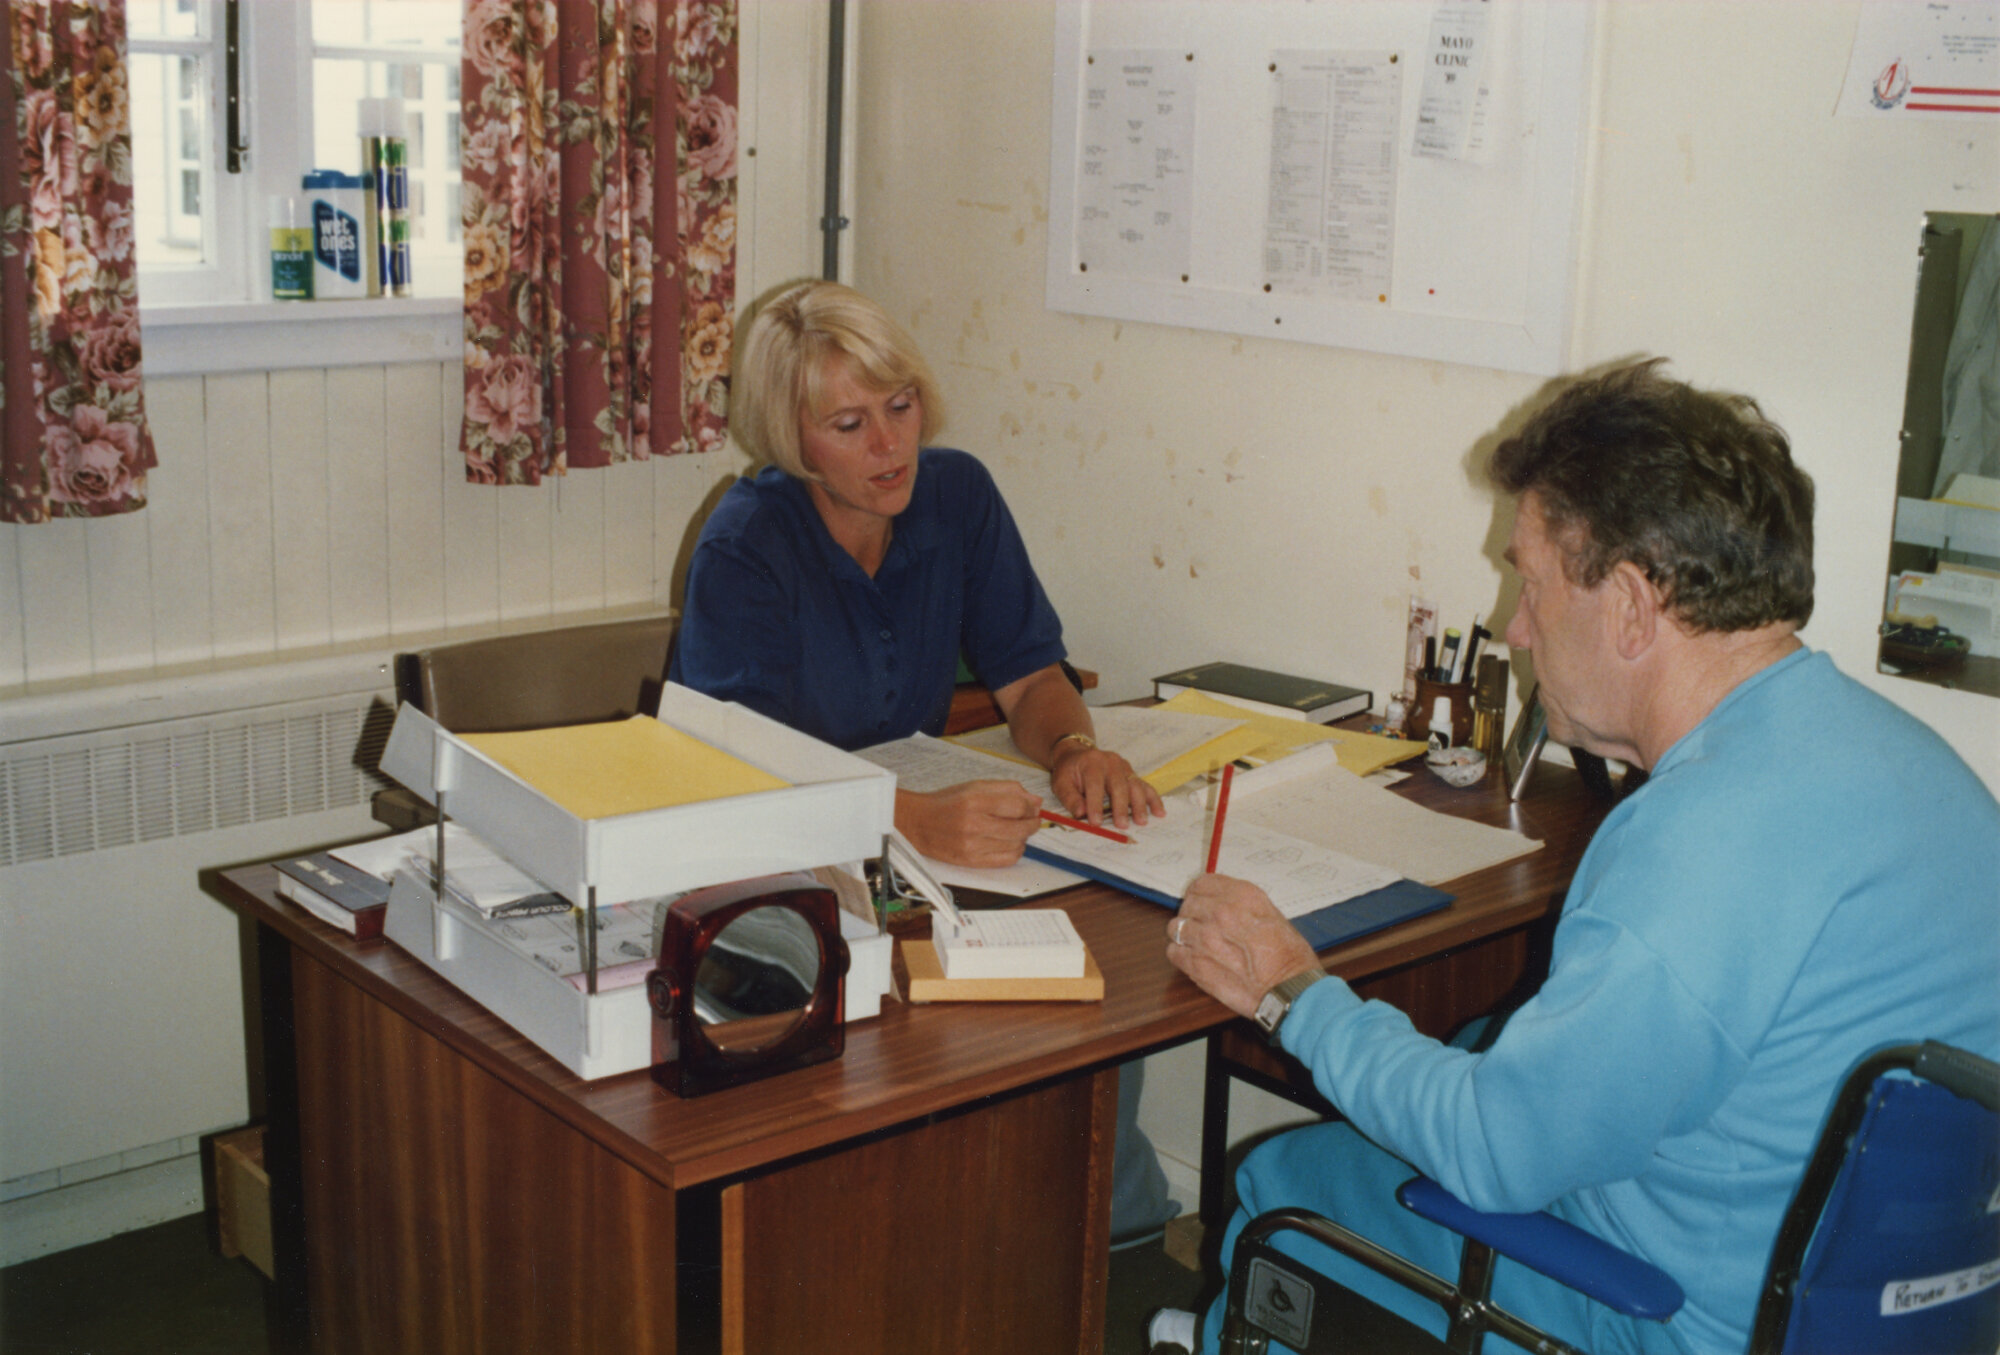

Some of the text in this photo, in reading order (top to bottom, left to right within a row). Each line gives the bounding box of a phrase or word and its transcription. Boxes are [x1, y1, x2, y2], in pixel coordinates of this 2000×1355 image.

[1441, 35, 1474, 49] MAYO
[1435, 53, 1470, 67] CLINIC
[319, 218, 351, 235] wet
[320, 235, 356, 251] ones
